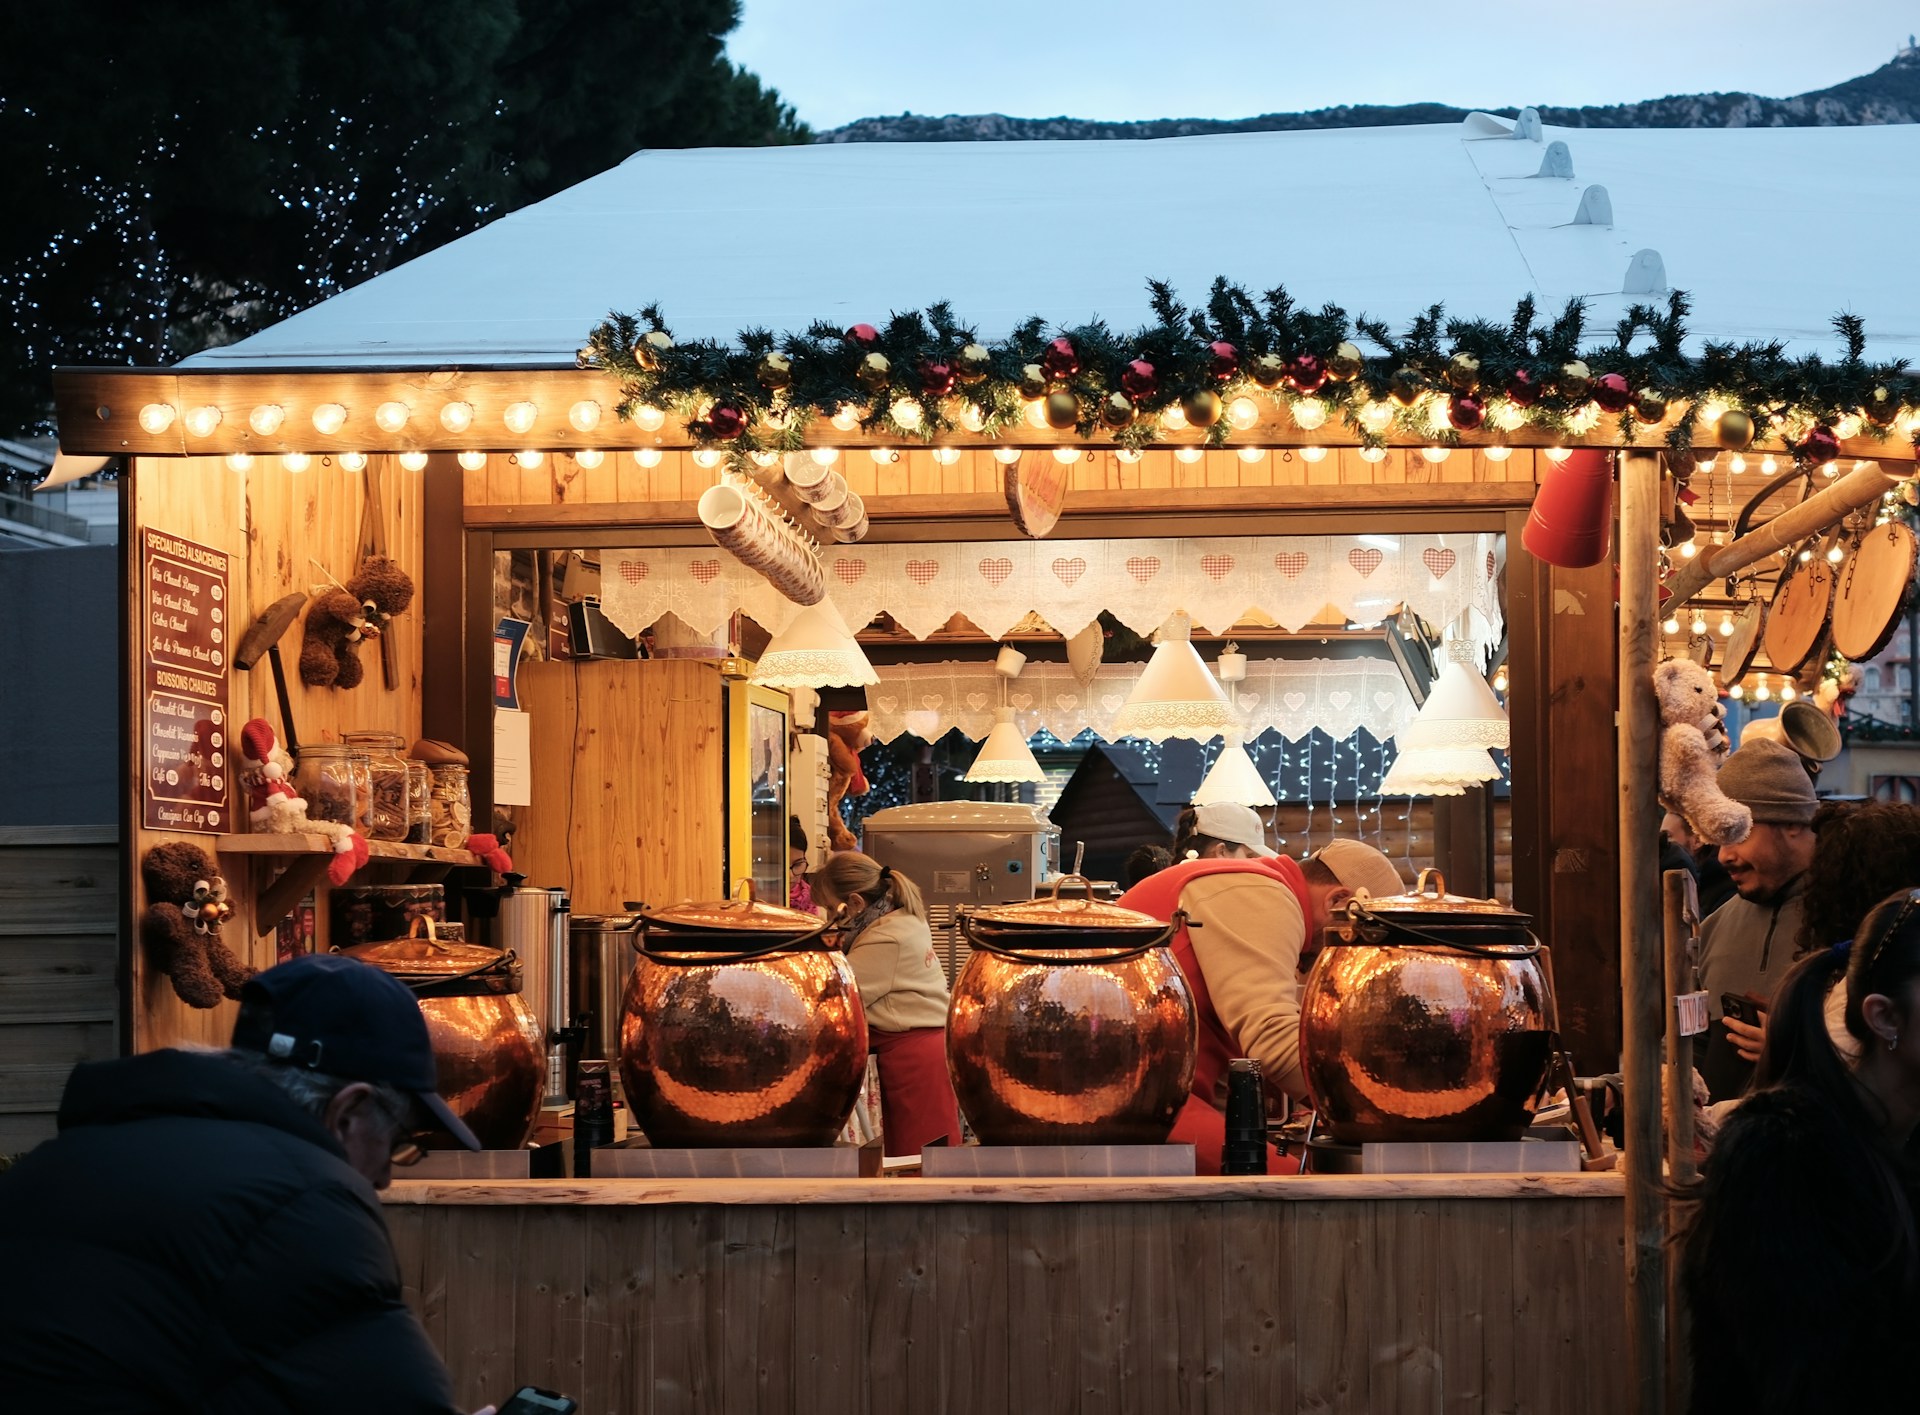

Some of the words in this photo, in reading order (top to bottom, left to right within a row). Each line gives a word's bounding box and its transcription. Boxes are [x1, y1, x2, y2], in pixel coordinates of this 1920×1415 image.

[187, 546, 227, 572] ALSACIENNES
[163, 570, 182, 588] Chaud
[182, 575, 200, 597] Rouge
[163, 593, 182, 611] Chaud
[182, 598, 199, 616] Blanc
[157, 670, 188, 691] BOISSONS
[188, 677, 217, 697] CHAUDES
[152, 698, 176, 716] Chocolat
